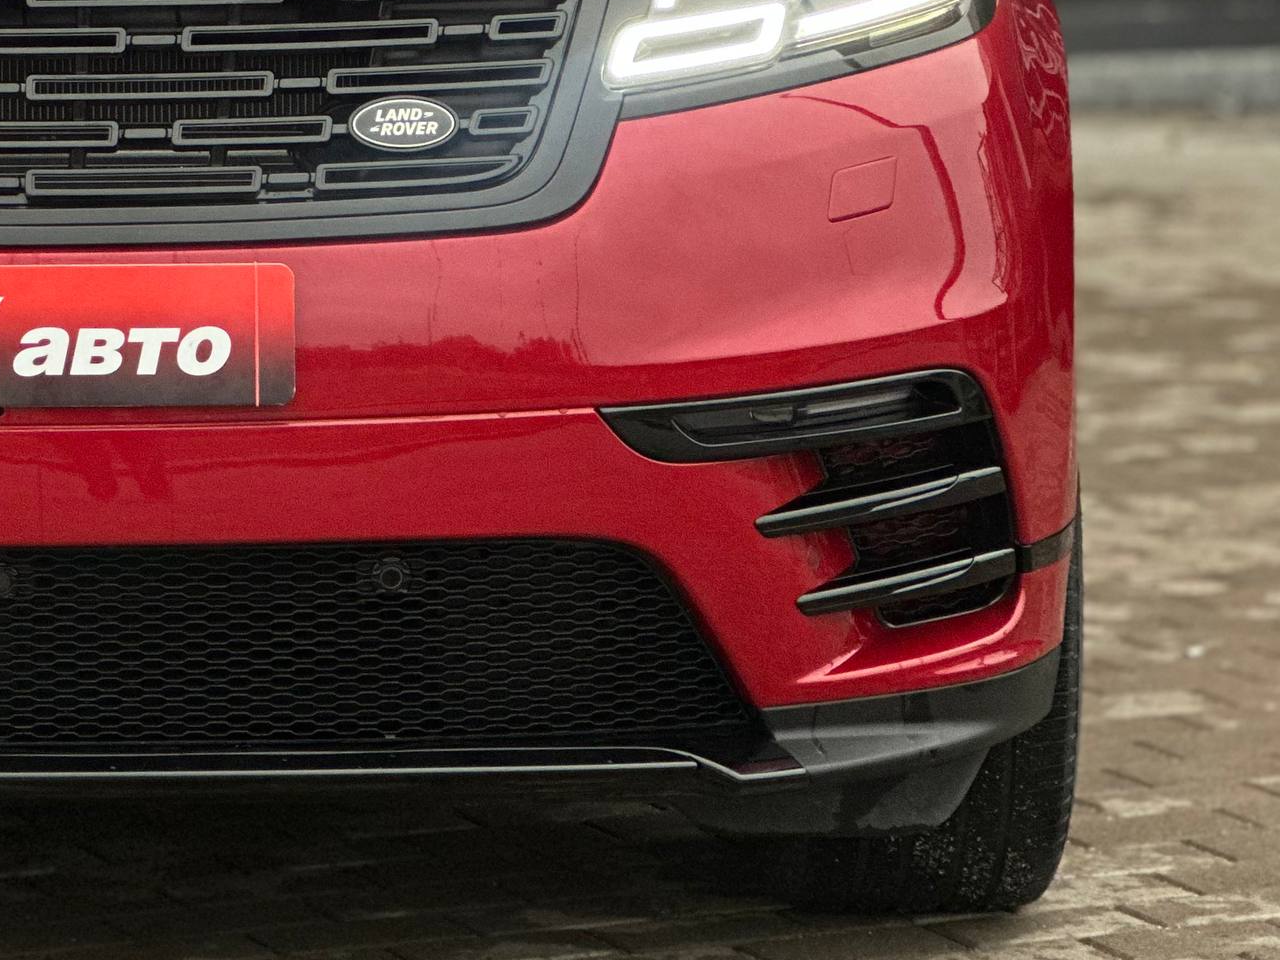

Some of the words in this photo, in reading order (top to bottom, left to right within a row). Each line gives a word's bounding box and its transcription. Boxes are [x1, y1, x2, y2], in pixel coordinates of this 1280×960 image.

[375, 107, 423, 122] LAND
[380, 121, 438, 136] ROVER
[12, 325, 232, 377] авто
